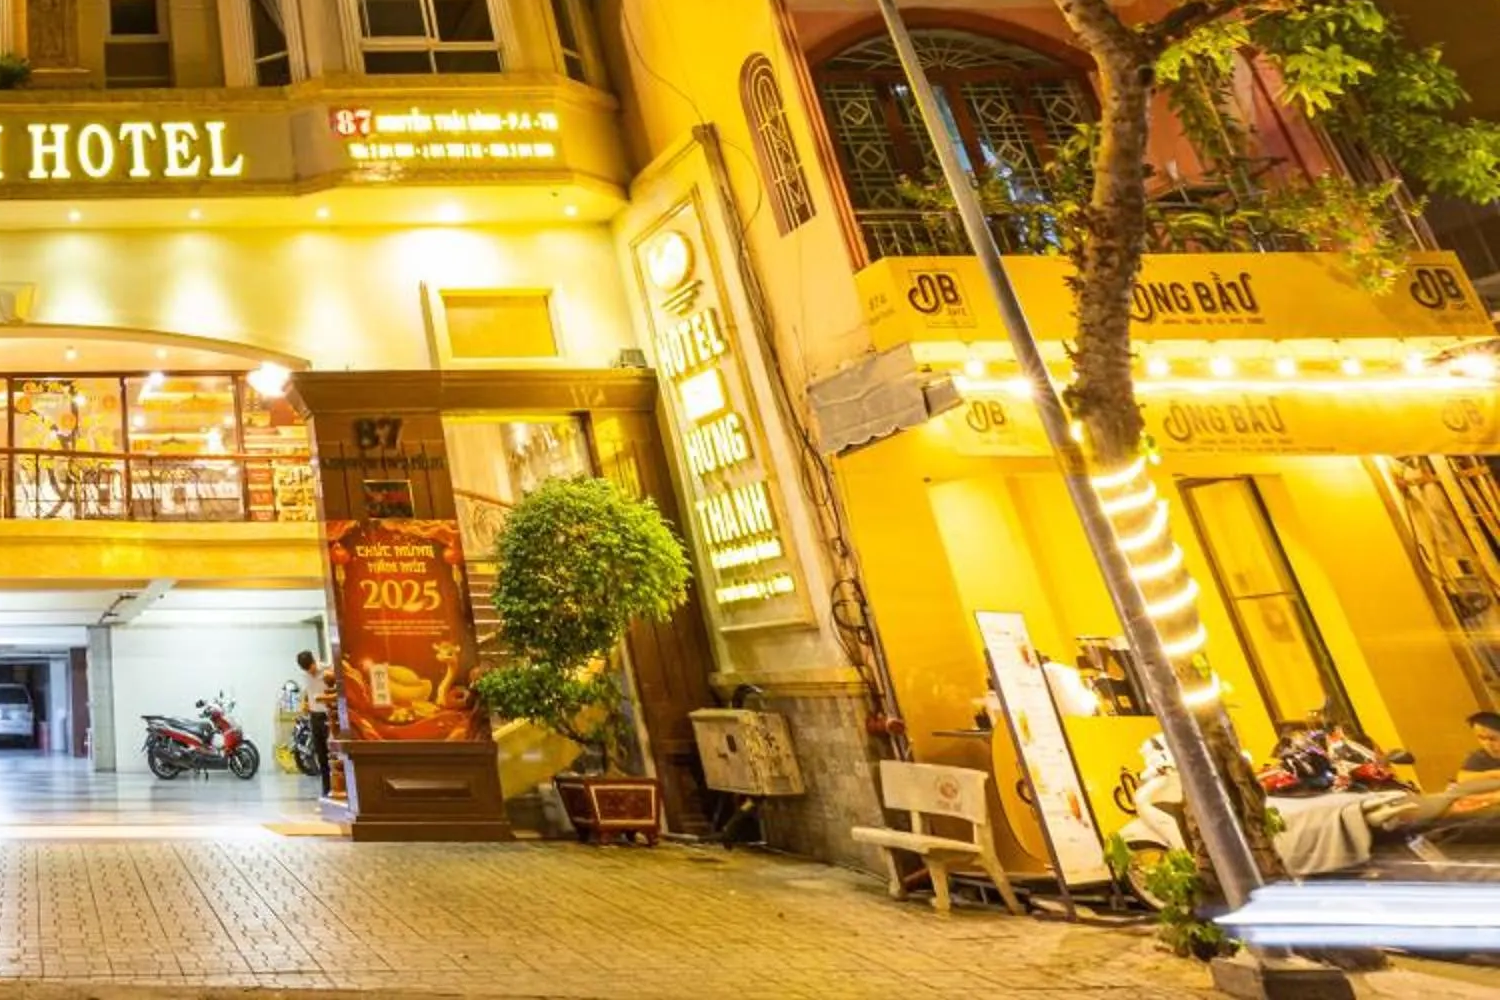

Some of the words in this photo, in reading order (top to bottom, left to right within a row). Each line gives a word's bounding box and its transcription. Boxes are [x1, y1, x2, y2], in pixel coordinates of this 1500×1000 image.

[335, 109, 371, 135] 87
[27, 121, 245, 180] HOTEL
[656, 307, 725, 380] HOTEL
[359, 579, 442, 612] 2025
